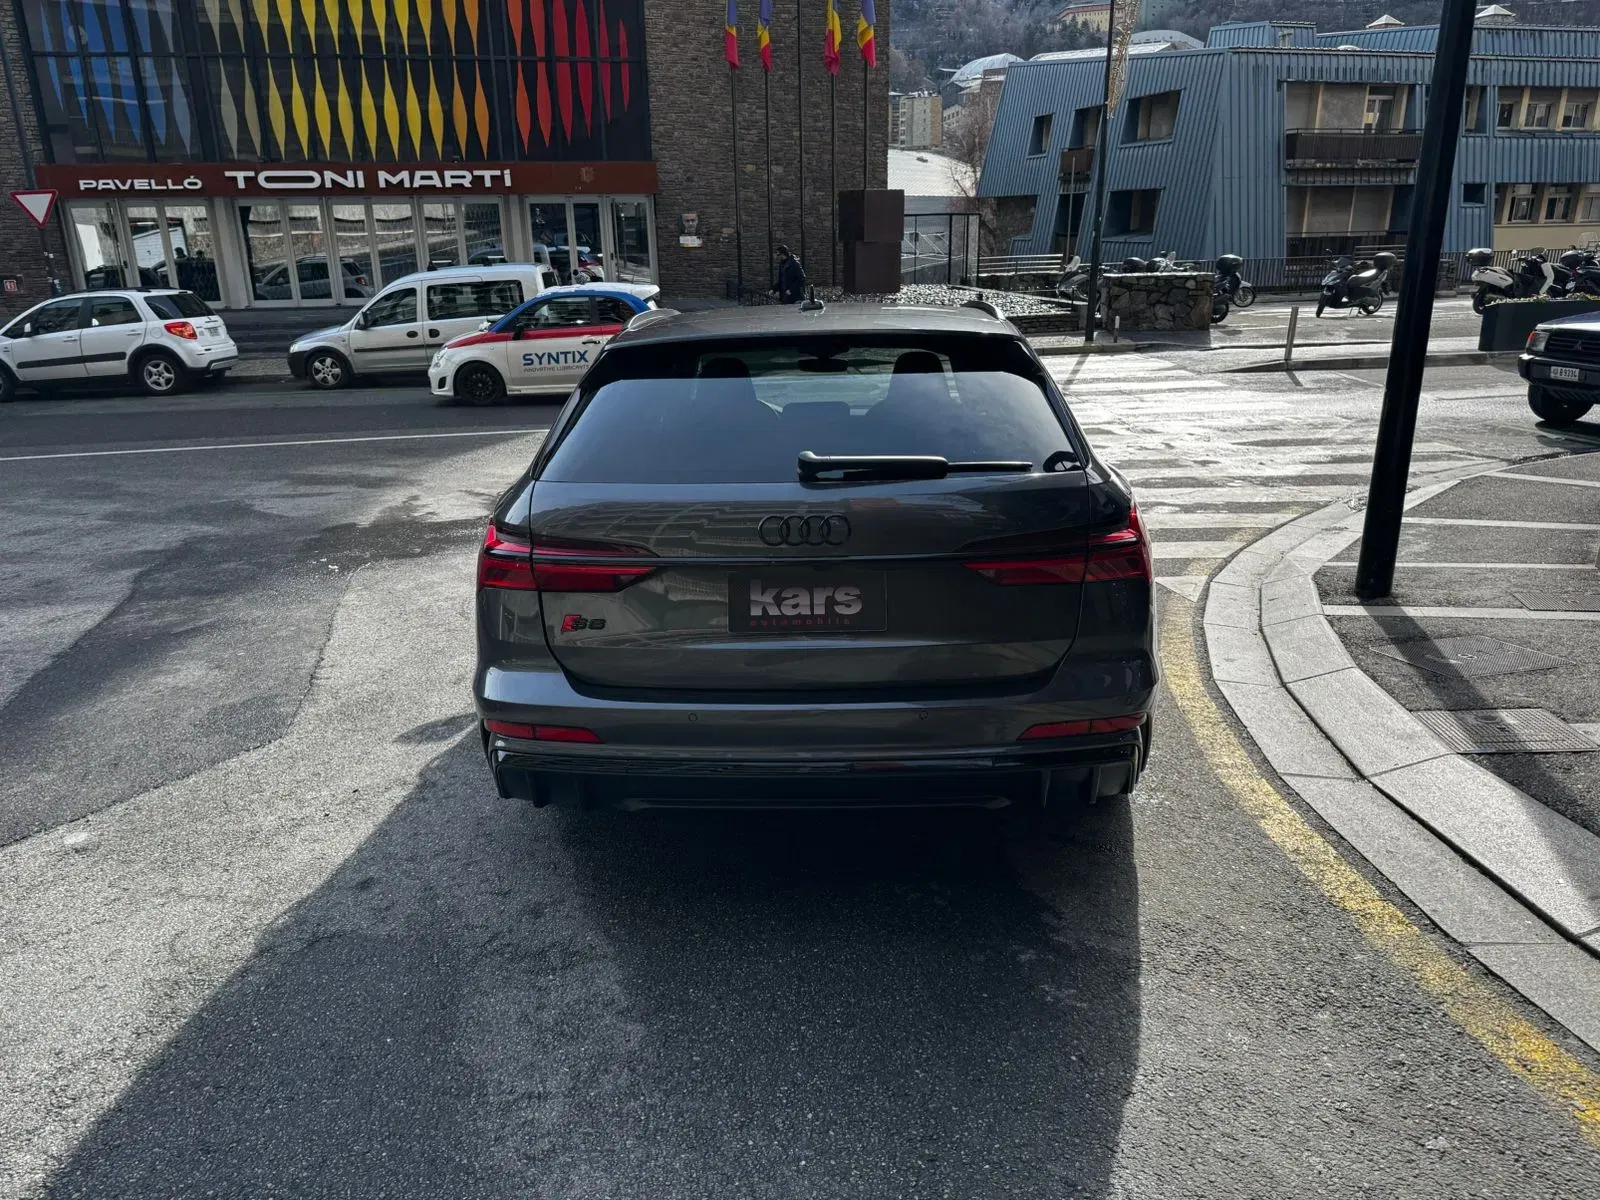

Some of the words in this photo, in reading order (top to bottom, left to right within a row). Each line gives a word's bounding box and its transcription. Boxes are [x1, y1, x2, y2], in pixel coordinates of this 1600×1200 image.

[78, 175, 203, 191] PAVELLÓ
[224, 169, 365, 190] TONI
[522, 349, 589, 366] SYNTIX
[750, 579, 864, 616] kars
